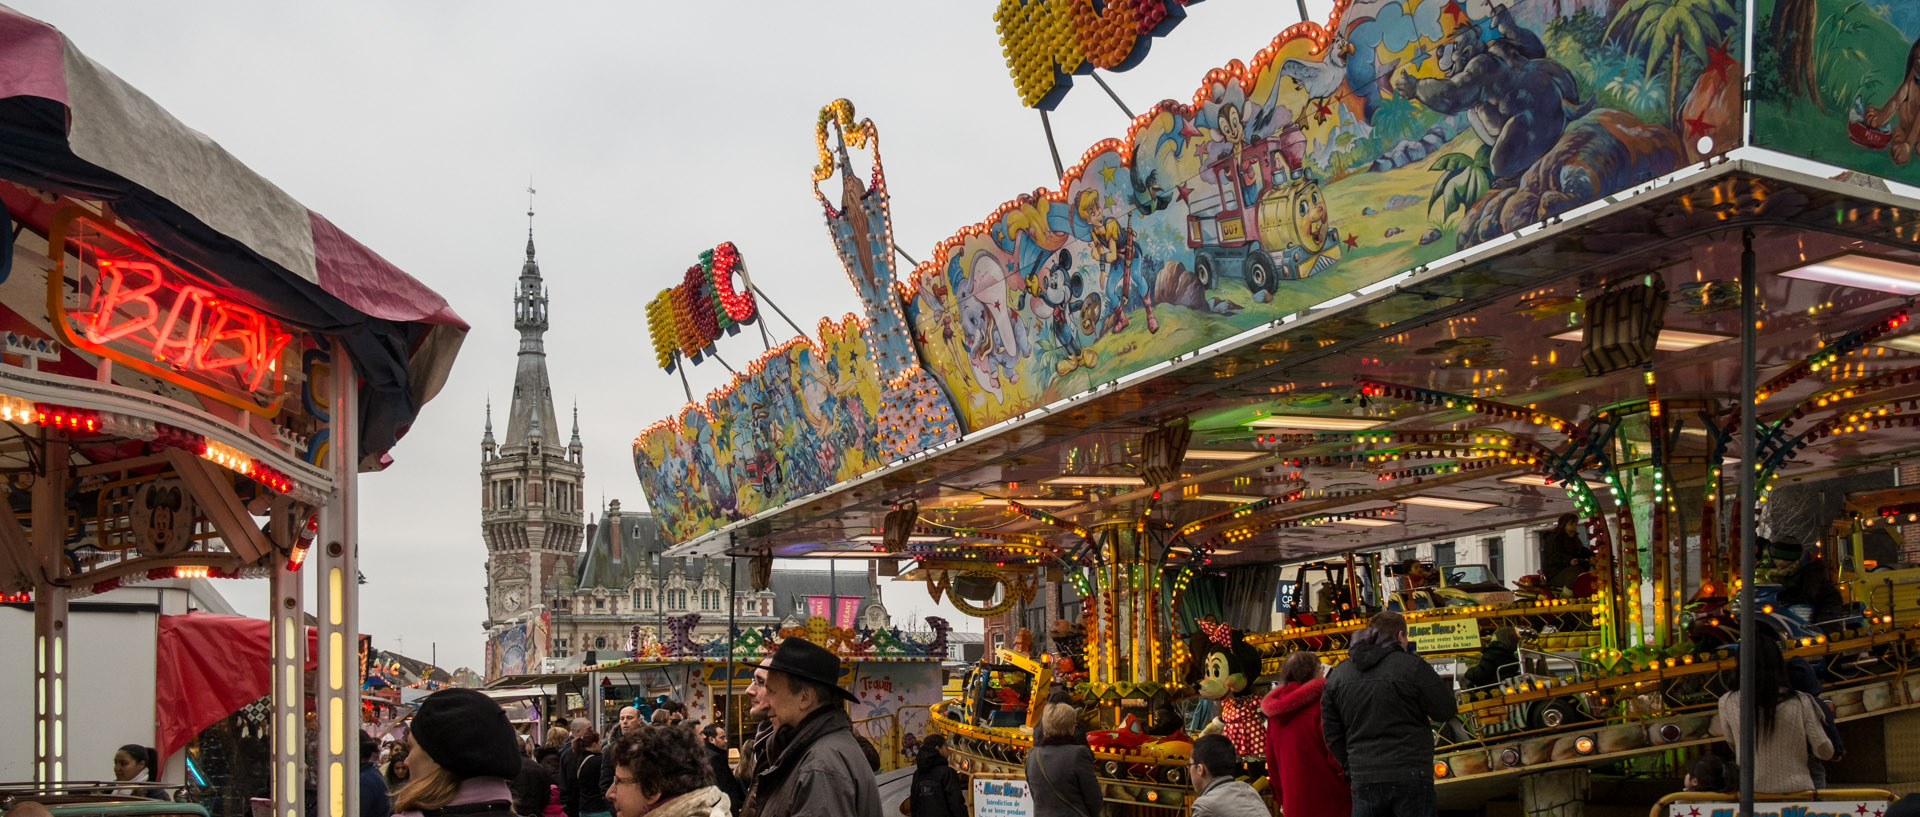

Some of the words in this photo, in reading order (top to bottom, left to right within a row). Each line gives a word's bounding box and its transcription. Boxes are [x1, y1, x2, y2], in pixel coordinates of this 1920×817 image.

[85, 257, 292, 392] BABY
[1408, 625, 1431, 637] MAGIC
[1431, 622, 1456, 635] WORLD
[983, 781, 1003, 795] MAGIC
[1003, 782, 1024, 798] WORLD
